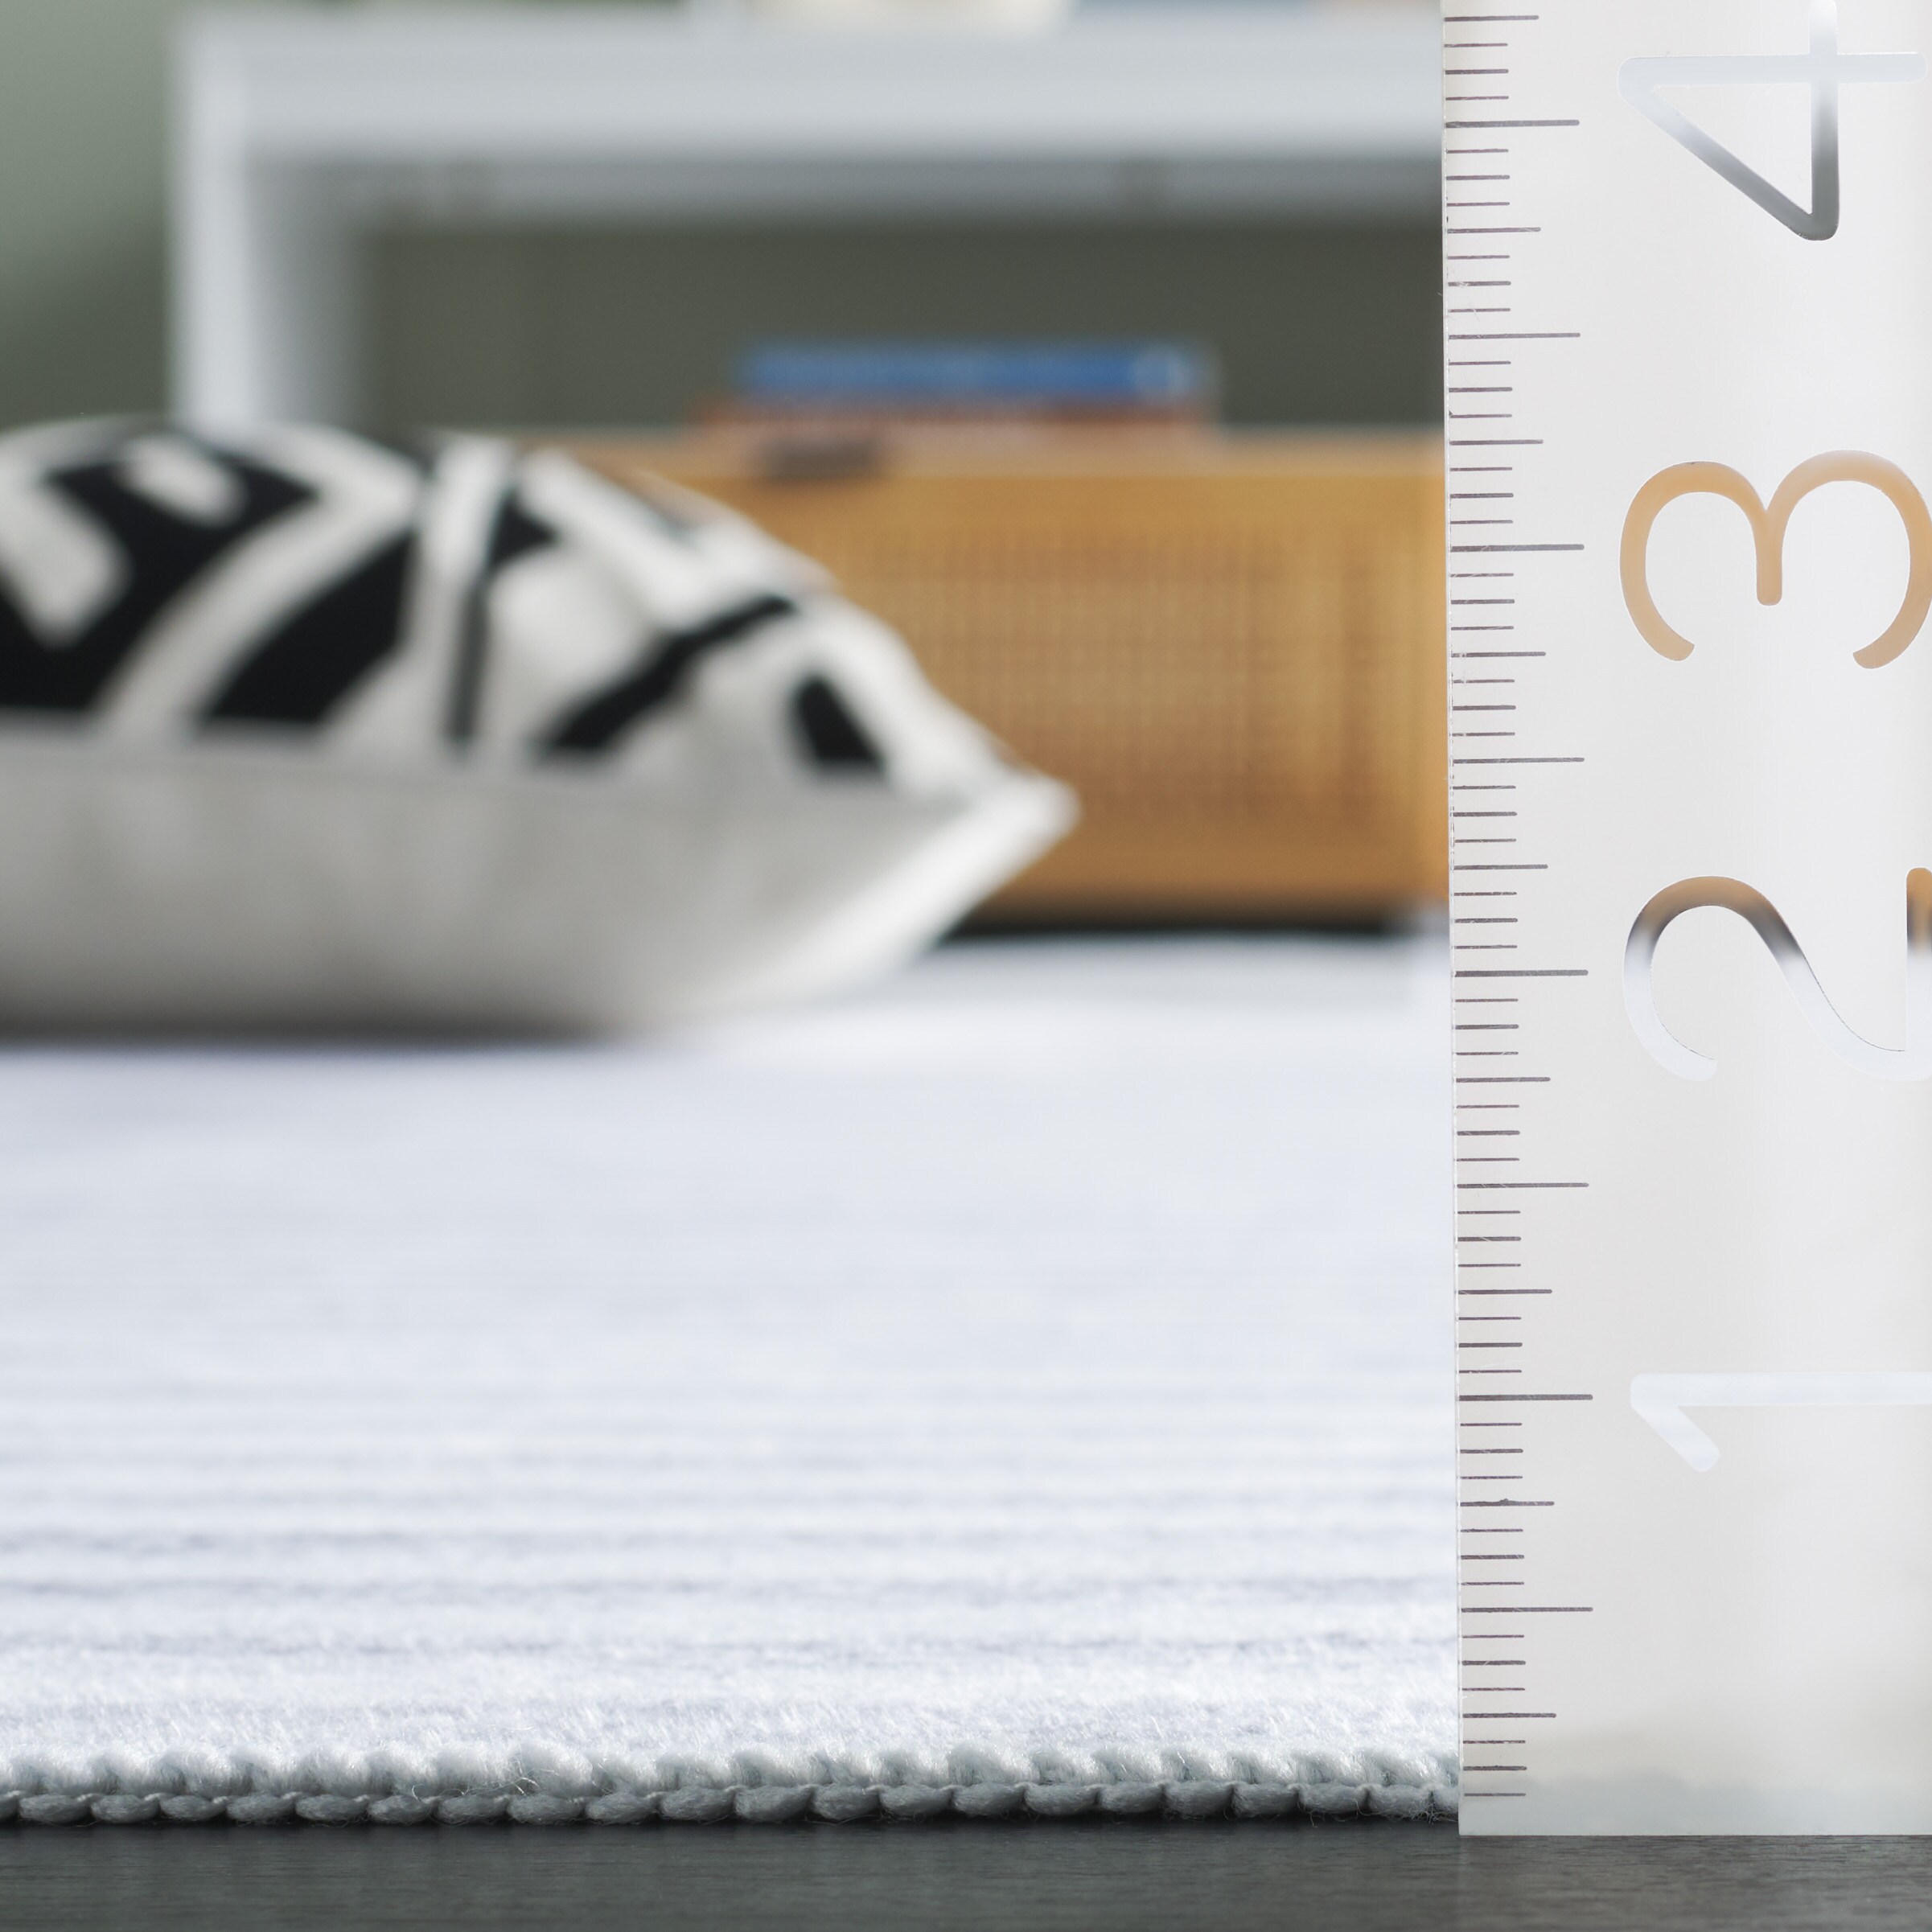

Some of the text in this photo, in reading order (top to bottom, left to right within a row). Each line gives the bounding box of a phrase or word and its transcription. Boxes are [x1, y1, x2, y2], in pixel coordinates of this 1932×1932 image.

[1618, 0, 1928, 240] 4
[1620, 450, 1932, 669] 3
[1622, 867, 1932, 1082] 2
[1630, 1371, 1932, 1472] 1
